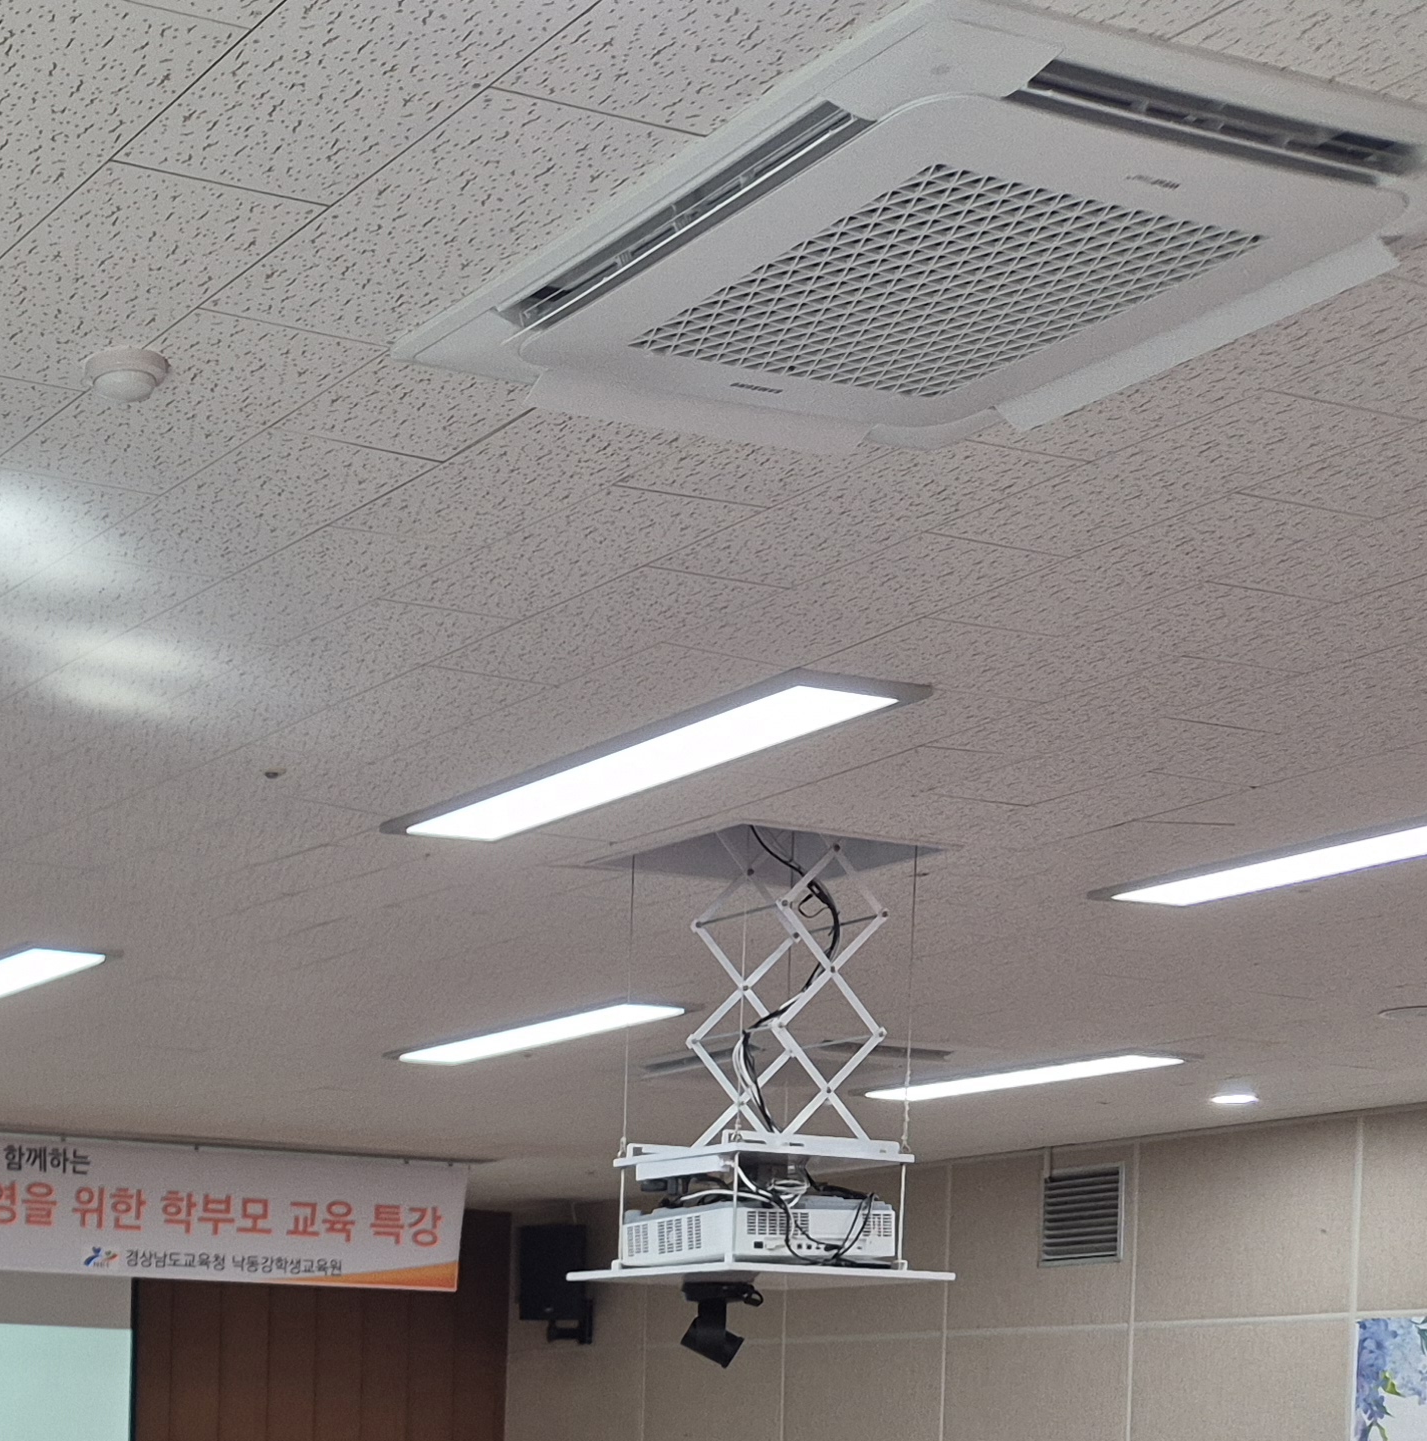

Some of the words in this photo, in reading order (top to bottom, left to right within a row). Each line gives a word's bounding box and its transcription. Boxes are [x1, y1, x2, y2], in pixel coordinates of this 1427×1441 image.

[4, 1143, 92, 1176] 함께하는
[72, 1183, 148, 1233] 위한
[160, 1189, 277, 1238] 학부모
[285, 1197, 357, 1243] 교육
[368, 1201, 443, 1247] 특강
[126, 1249, 227, 1271] 경상남도교육청
[231, 1254, 343, 1276] 낙동강학생교육원
